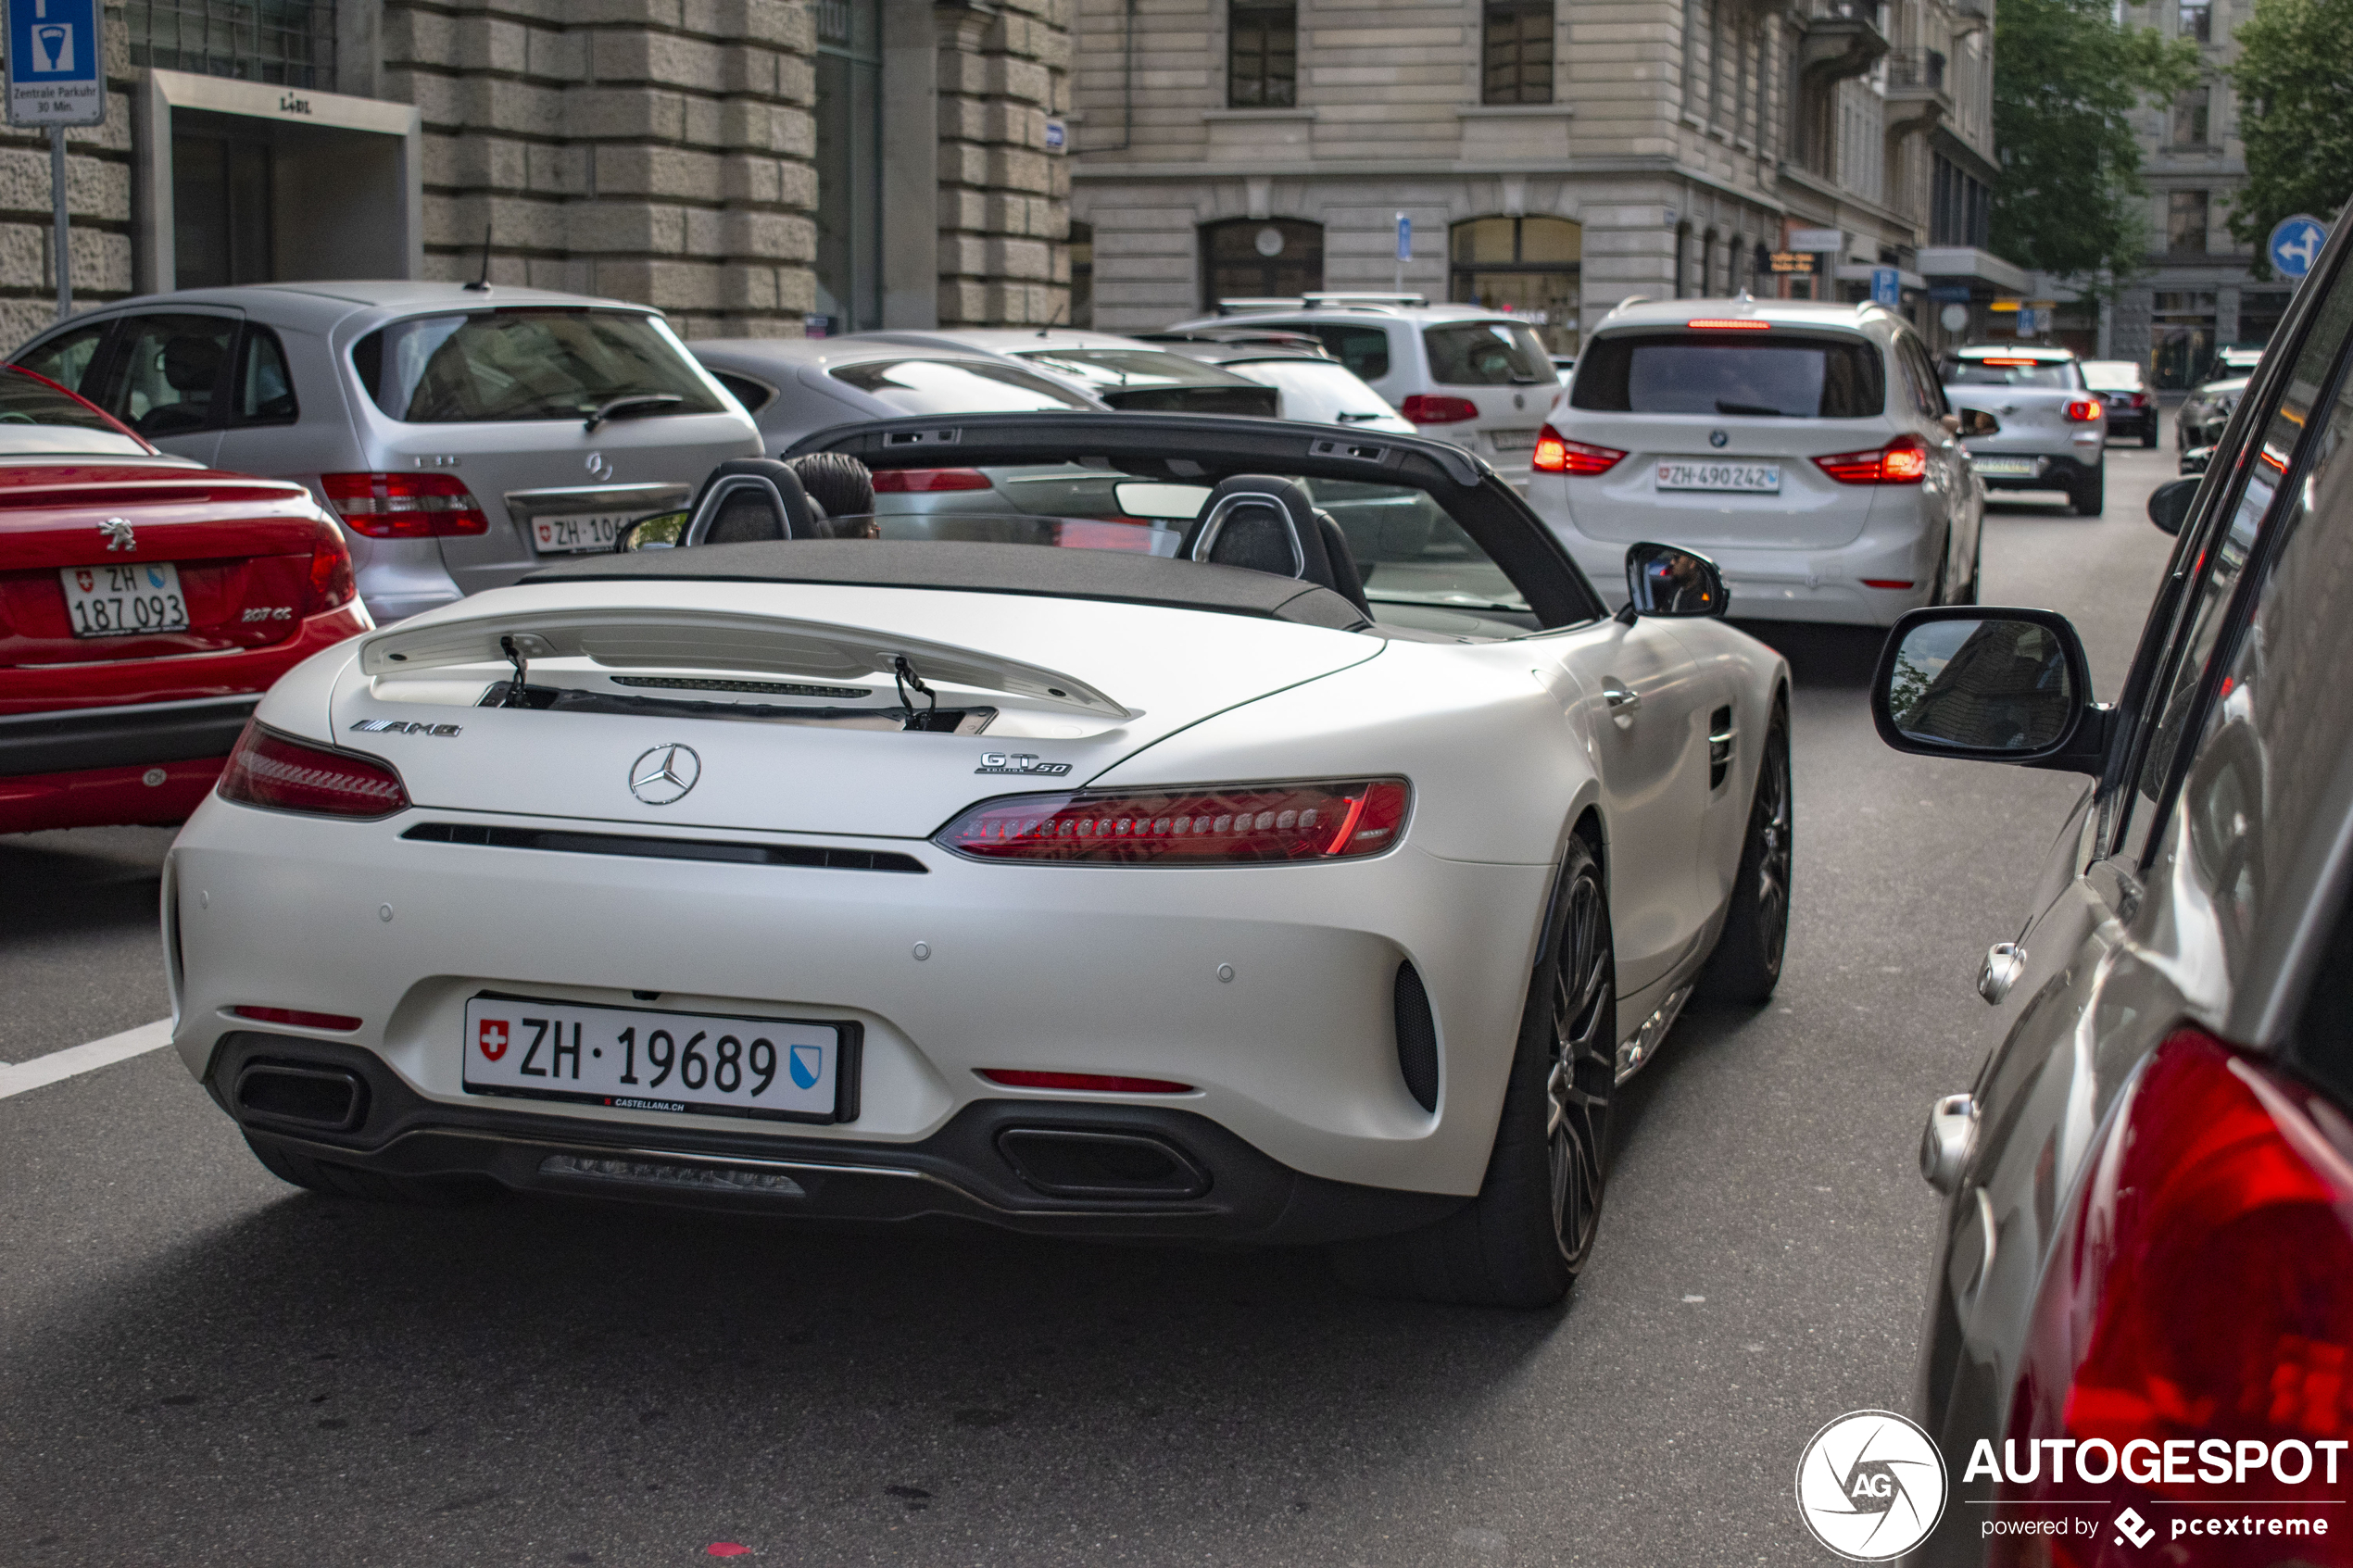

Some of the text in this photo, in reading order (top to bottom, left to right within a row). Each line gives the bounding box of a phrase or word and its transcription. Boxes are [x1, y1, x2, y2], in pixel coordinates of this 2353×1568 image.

[14, 85, 96, 99] Zentrale Parkuhr
[38, 101, 50, 112] 30
[105, 566, 137, 592] ZH
[75, 594, 184, 633] 187 093
[242, 607, 272, 623] 207
[384, 721, 463, 737] AMG
[981, 752, 1039, 769] GT
[1036, 764, 1068, 772] 50
[615, 1098, 685, 1112] CASTELLANA.CH
